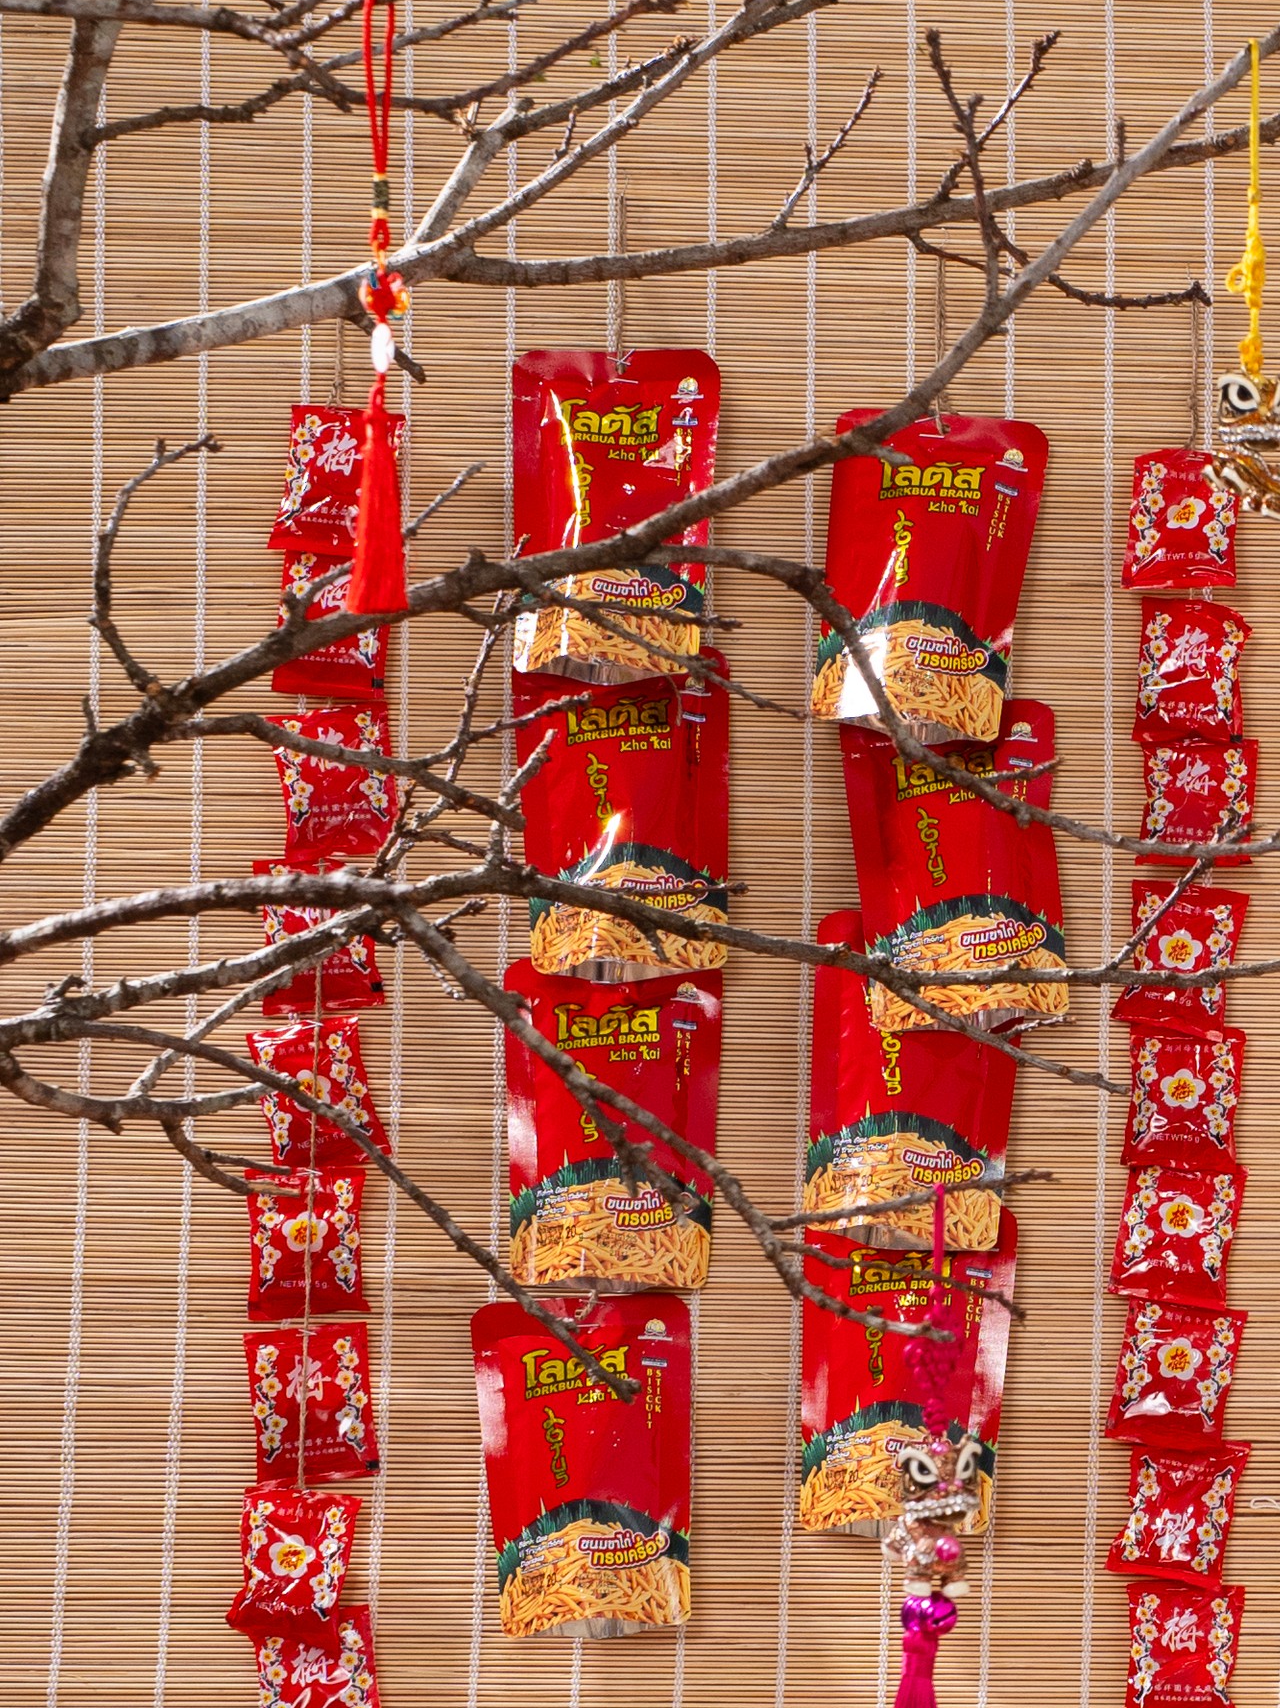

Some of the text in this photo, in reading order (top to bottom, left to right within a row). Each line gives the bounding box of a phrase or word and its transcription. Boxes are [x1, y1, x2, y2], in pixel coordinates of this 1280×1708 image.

[940, 487, 981, 499] BRAND
[618, 1032, 661, 1045] BRAND
[1161, 1607, 1205, 1653] 梅
